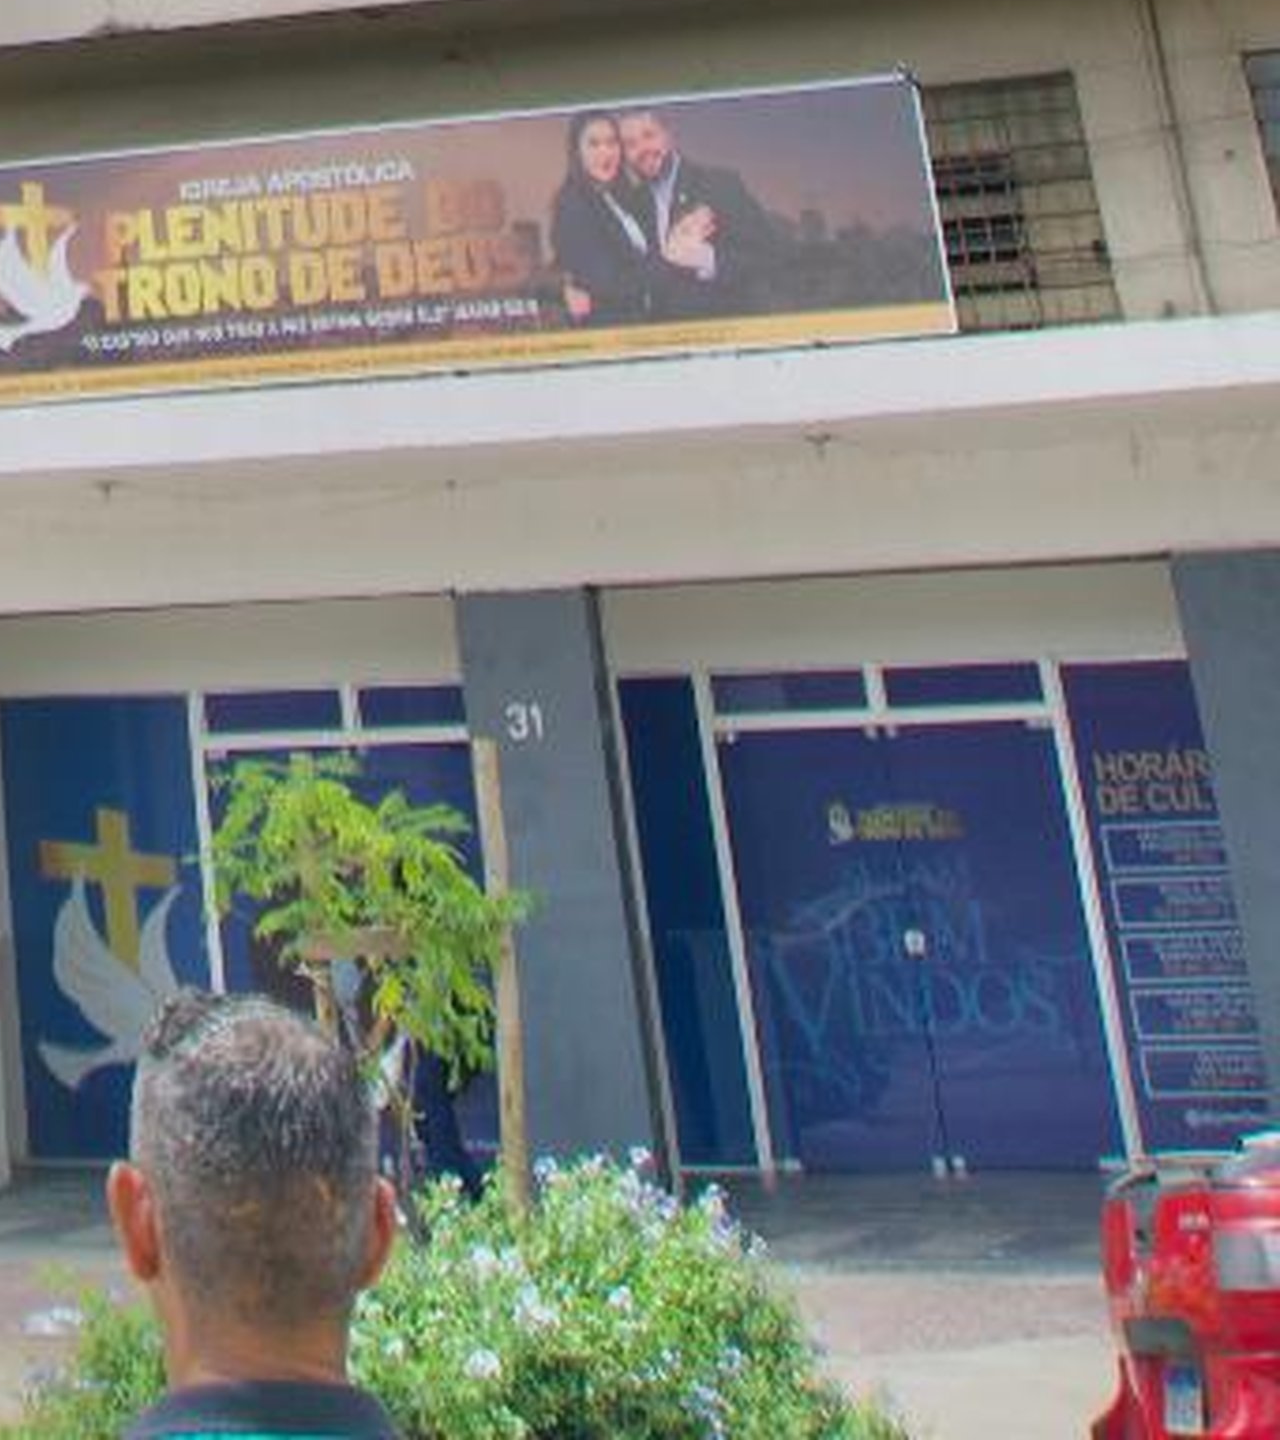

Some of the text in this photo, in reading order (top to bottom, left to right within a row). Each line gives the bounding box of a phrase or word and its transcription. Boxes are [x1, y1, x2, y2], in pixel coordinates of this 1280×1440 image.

[179, 175, 261, 201] IGREJA
[107, 188, 405, 266] PLENITUDE
[93, 234, 526, 325] TRONO DE DEUS
[505, 701, 544, 742] 31
[1097, 784, 1141, 814] DE
